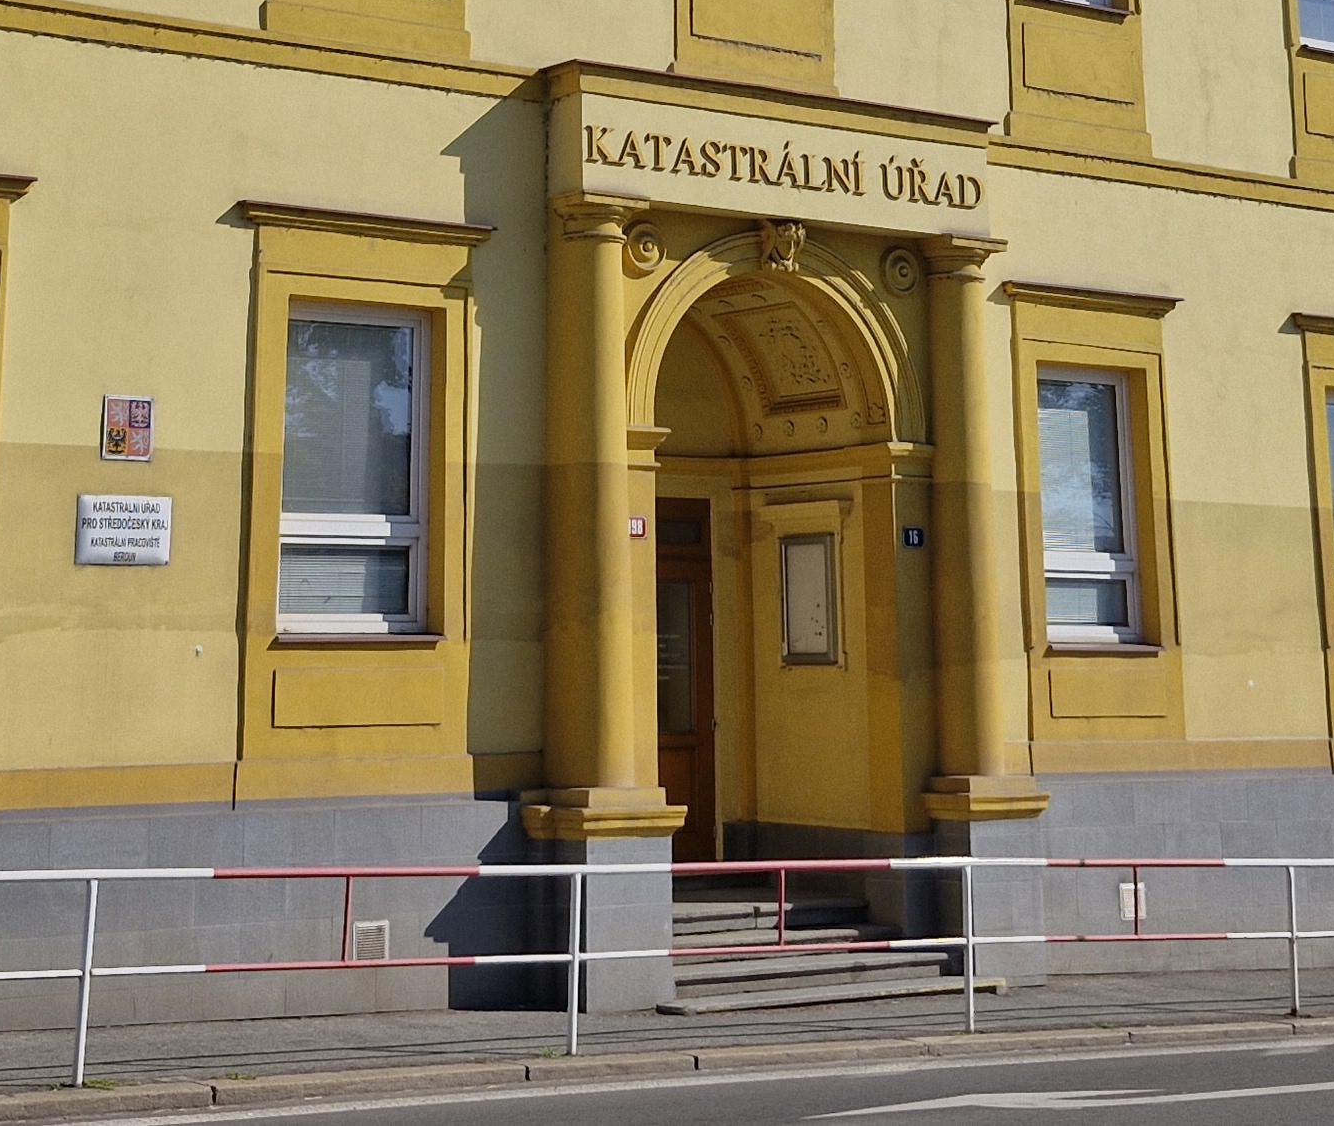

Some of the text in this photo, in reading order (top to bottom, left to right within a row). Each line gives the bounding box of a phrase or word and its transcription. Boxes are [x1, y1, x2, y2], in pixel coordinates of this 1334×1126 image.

[583, 124, 986, 210] KATASTRÁLNÍ ÚŘAD
[82, 515, 169, 531] PRO STŘEDOČESKÝ KRAJ
[908, 529, 919, 544] 16
[113, 552, 136, 562] BEROUN
